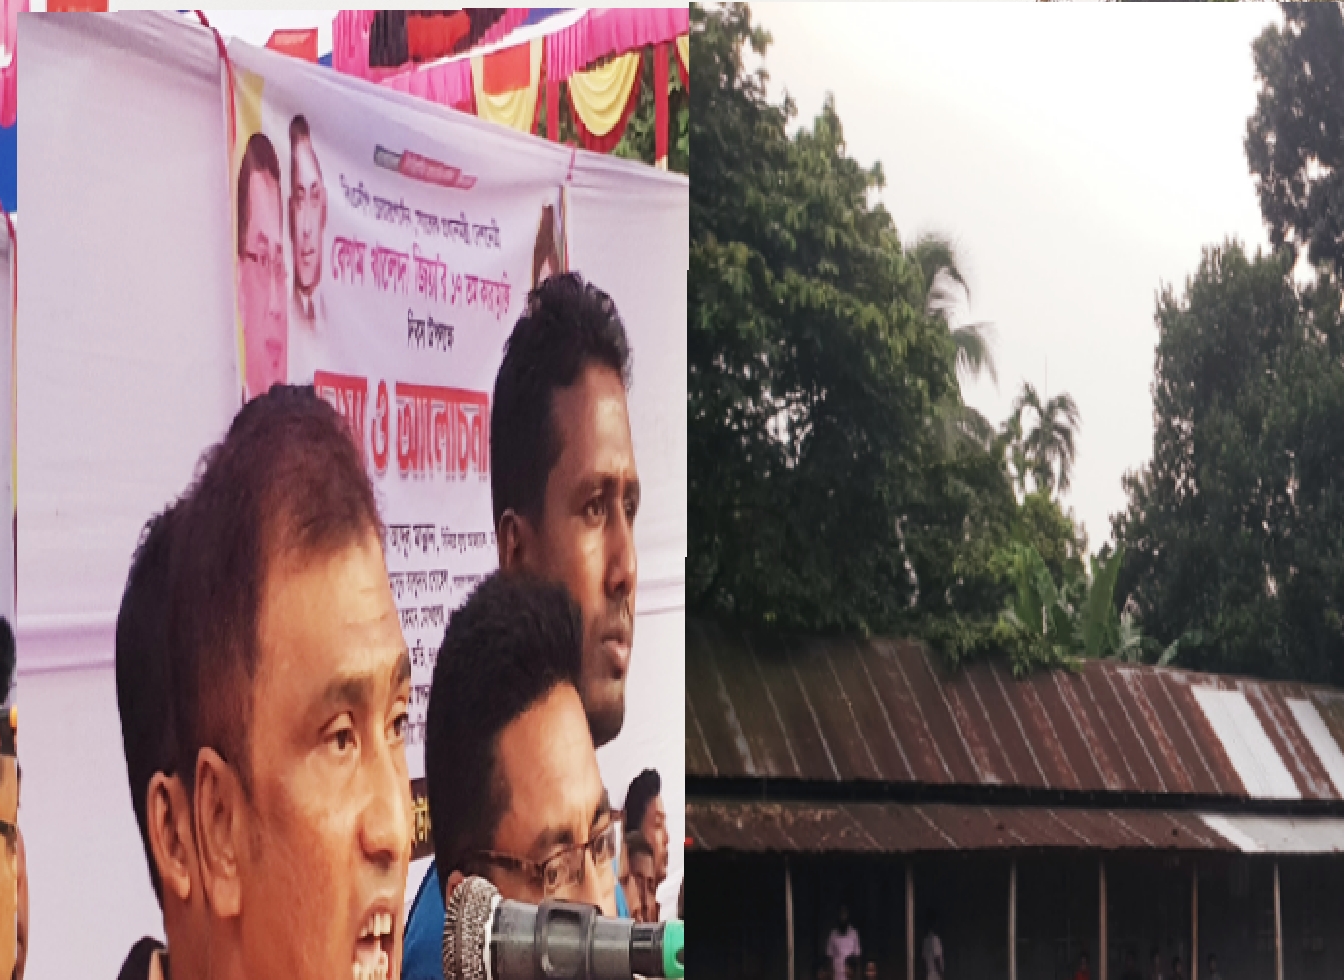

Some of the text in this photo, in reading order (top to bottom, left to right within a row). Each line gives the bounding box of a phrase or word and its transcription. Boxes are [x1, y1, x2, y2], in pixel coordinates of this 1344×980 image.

[330, 235, 368, 287] বেগম
[370, 239, 410, 296] খালেদা
[370, 378, 390, 480] ও
[395, 380, 491, 484] আলোচনা
